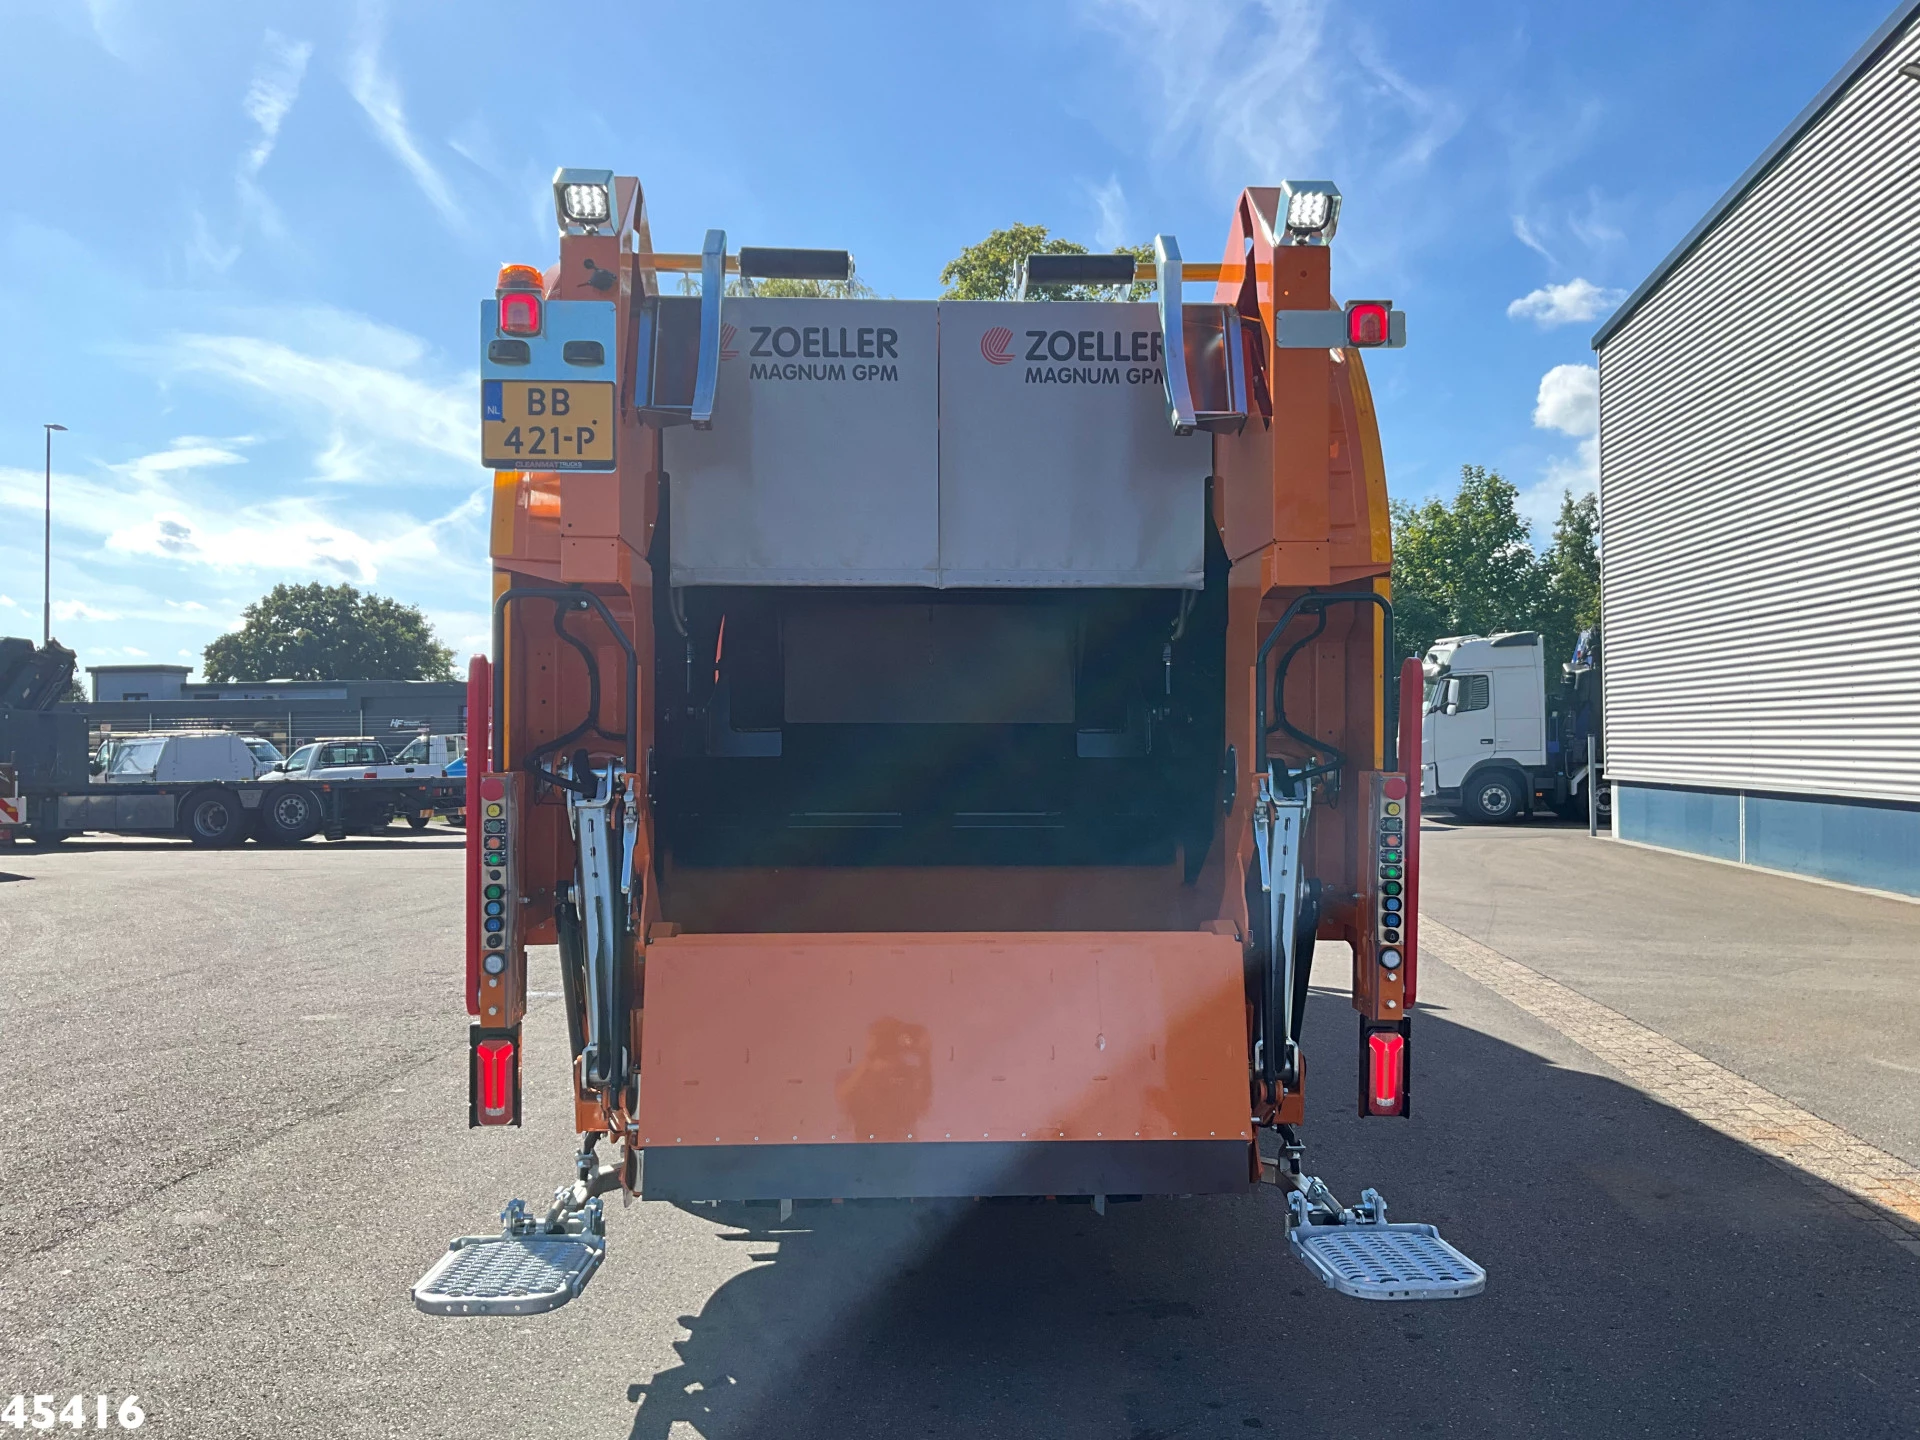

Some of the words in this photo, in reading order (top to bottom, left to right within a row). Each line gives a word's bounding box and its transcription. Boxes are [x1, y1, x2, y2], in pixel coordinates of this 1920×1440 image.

[749, 326, 898, 358] ZOELLER
[1025, 330, 1162, 362] ZOELLER
[749, 363, 846, 381] MAGNUM
[852, 364, 898, 381] GPM
[1025, 367, 1119, 384] MAGNUM
[487, 405, 501, 415] NL
[528, 388, 570, 416] BB
[504, 426, 595, 454] 421-P
